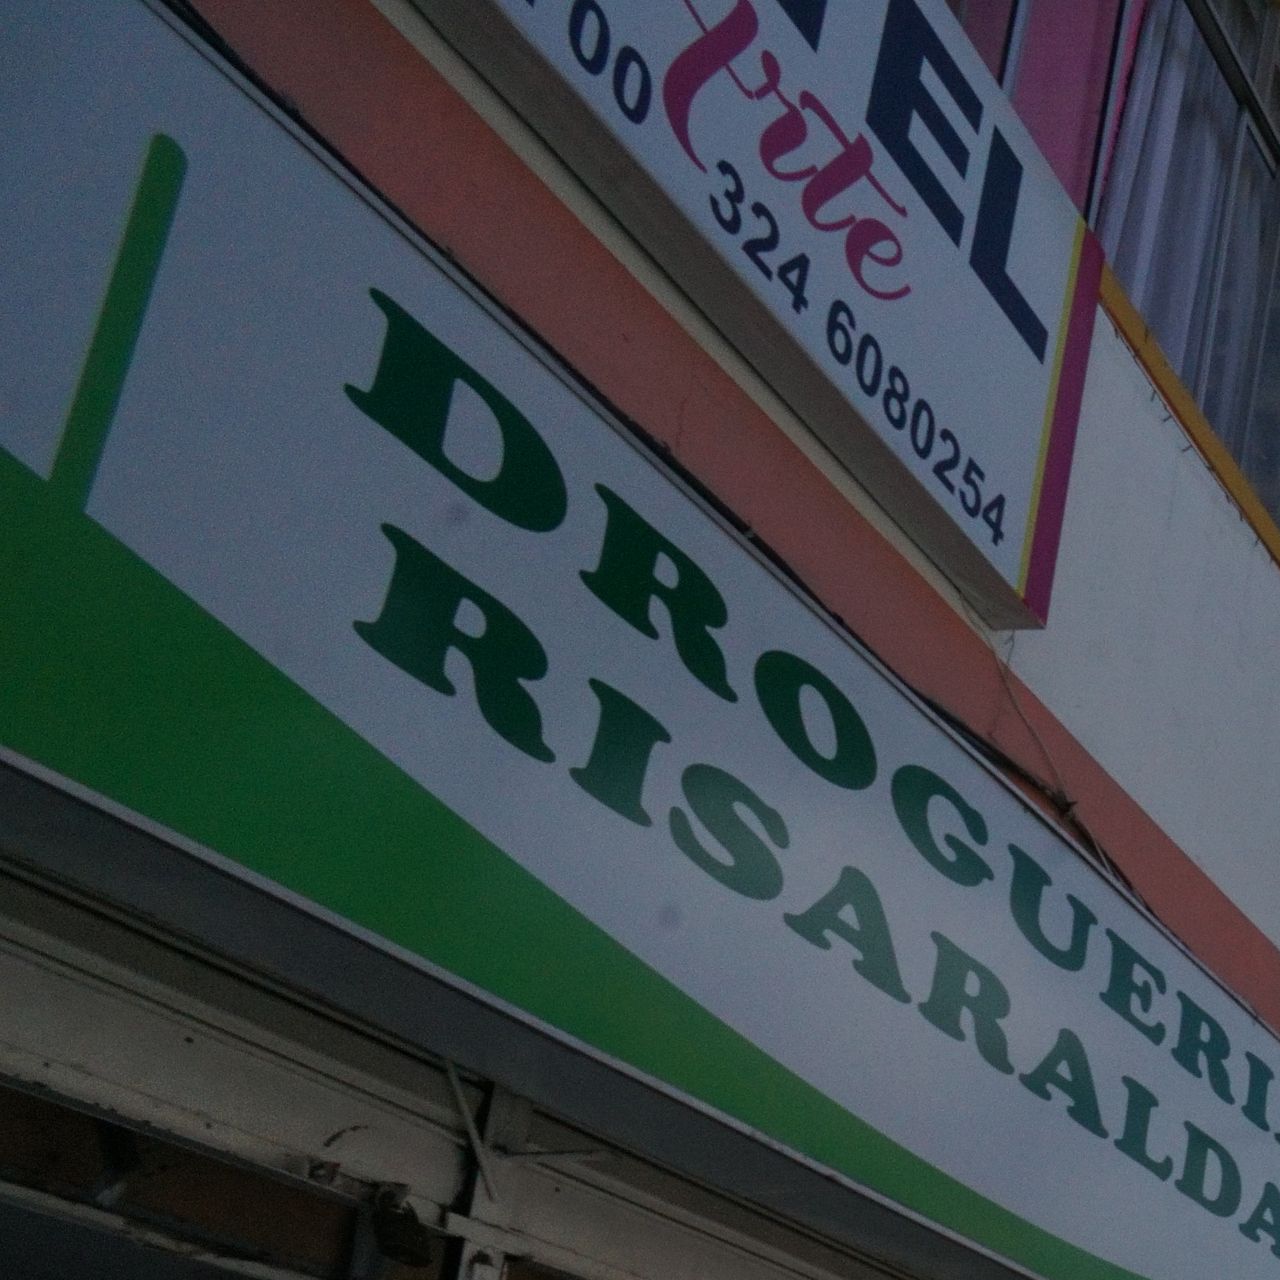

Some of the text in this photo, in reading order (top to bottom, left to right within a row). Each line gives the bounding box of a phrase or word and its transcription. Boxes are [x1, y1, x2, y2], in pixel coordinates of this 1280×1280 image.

[707, 160, 809, 313] 324
[824, 299, 1004, 546] 6080254
[775, 0, 1049, 365] EL
